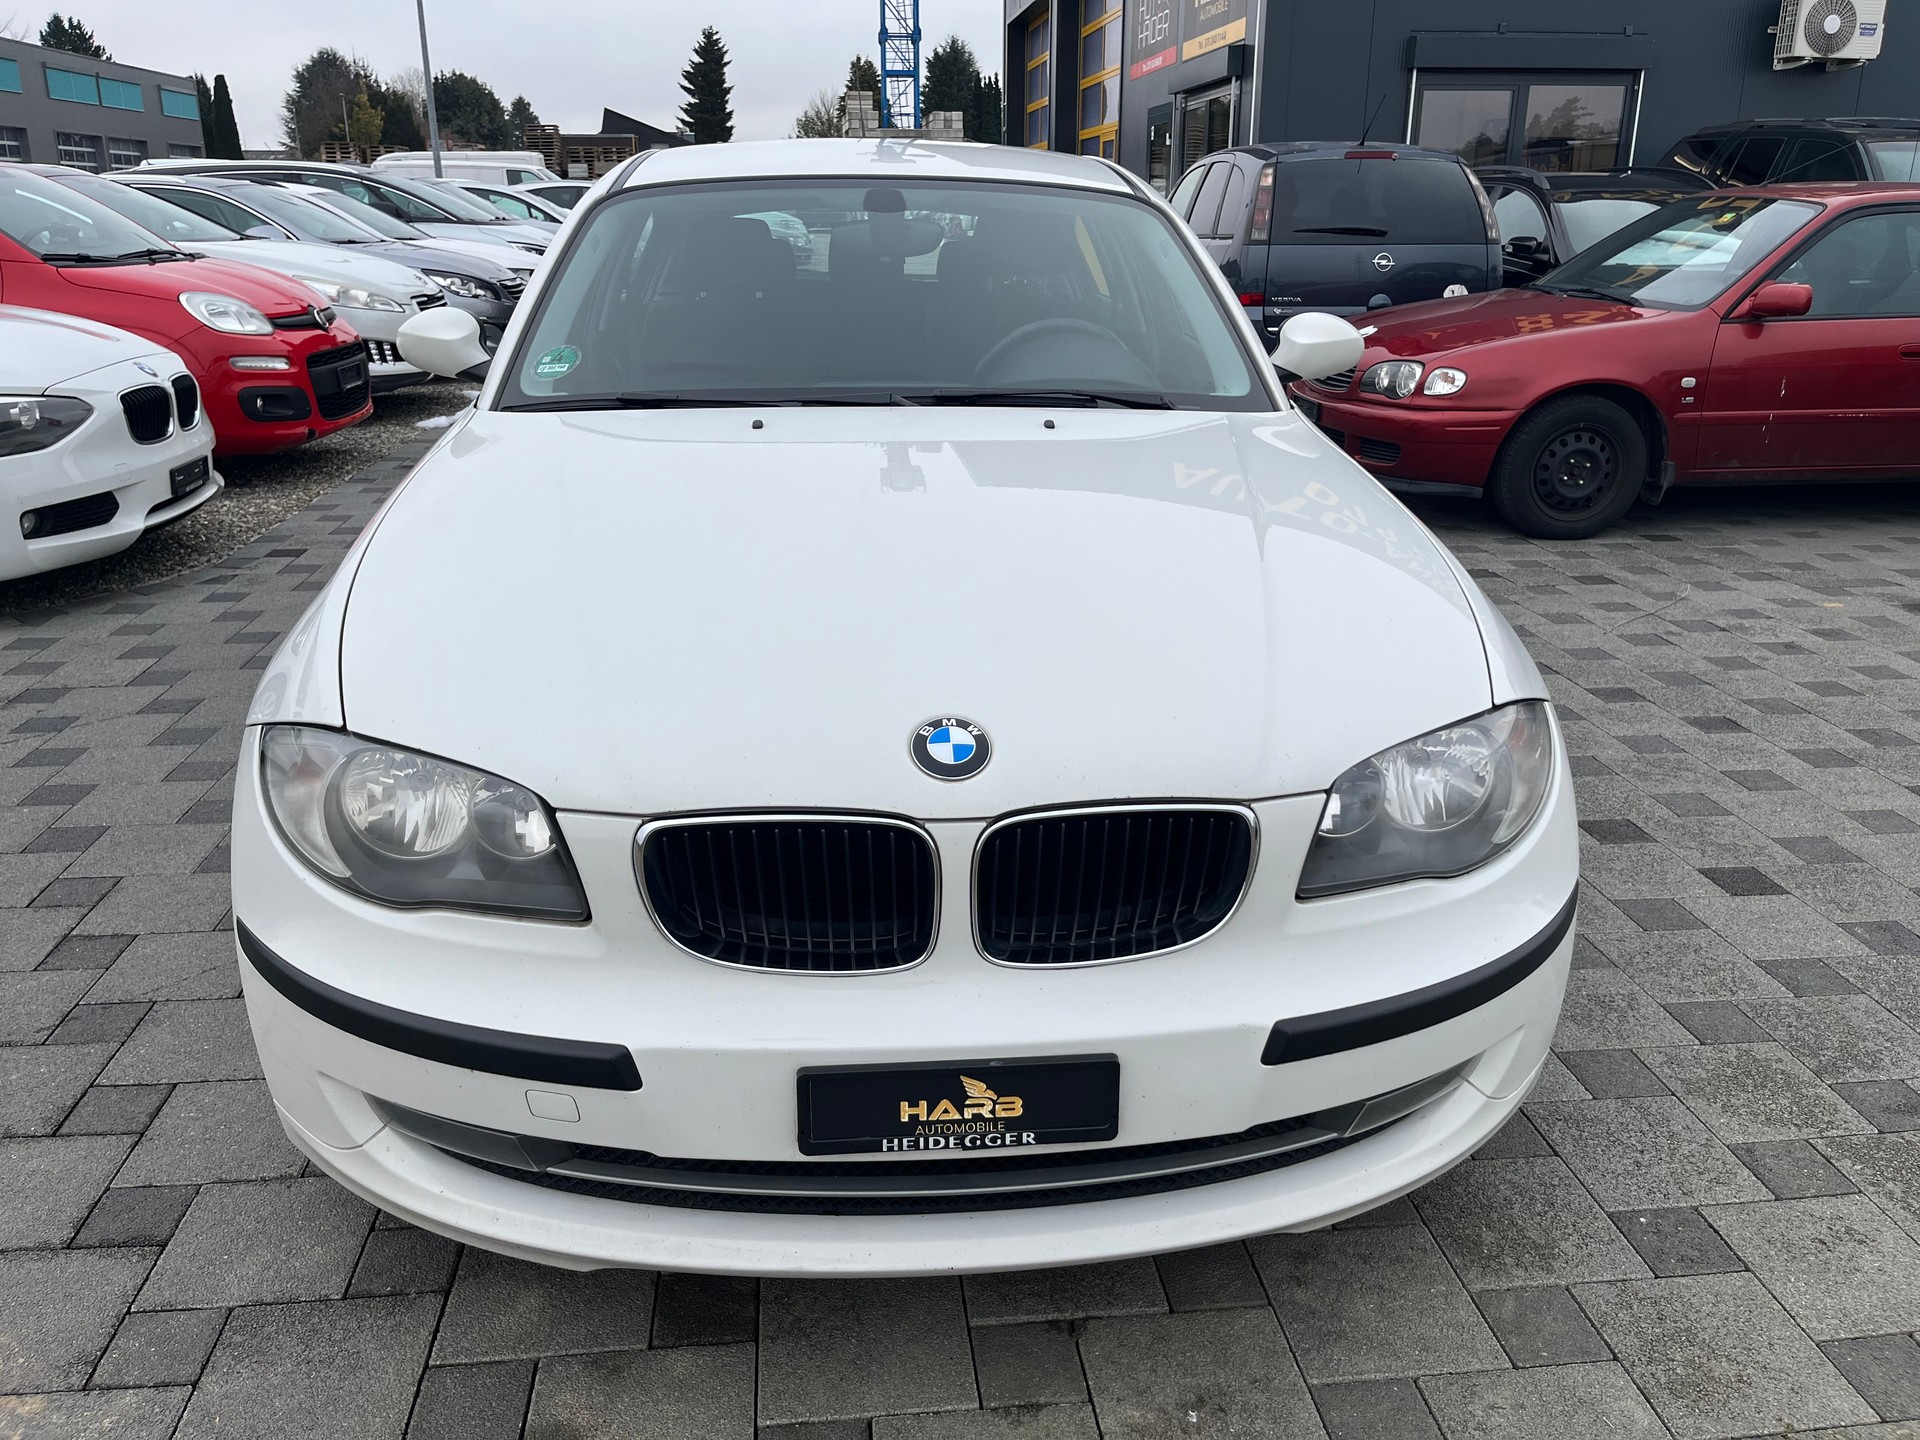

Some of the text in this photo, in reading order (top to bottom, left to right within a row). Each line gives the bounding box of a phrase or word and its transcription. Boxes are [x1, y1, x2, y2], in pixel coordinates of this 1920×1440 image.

[919, 718, 982, 737] BMW
[900, 1096, 1023, 1122] HARB
[915, 1121, 1006, 1136] AUTOMOBILE
[882, 1132, 1036, 1152] HEIDEGGER
